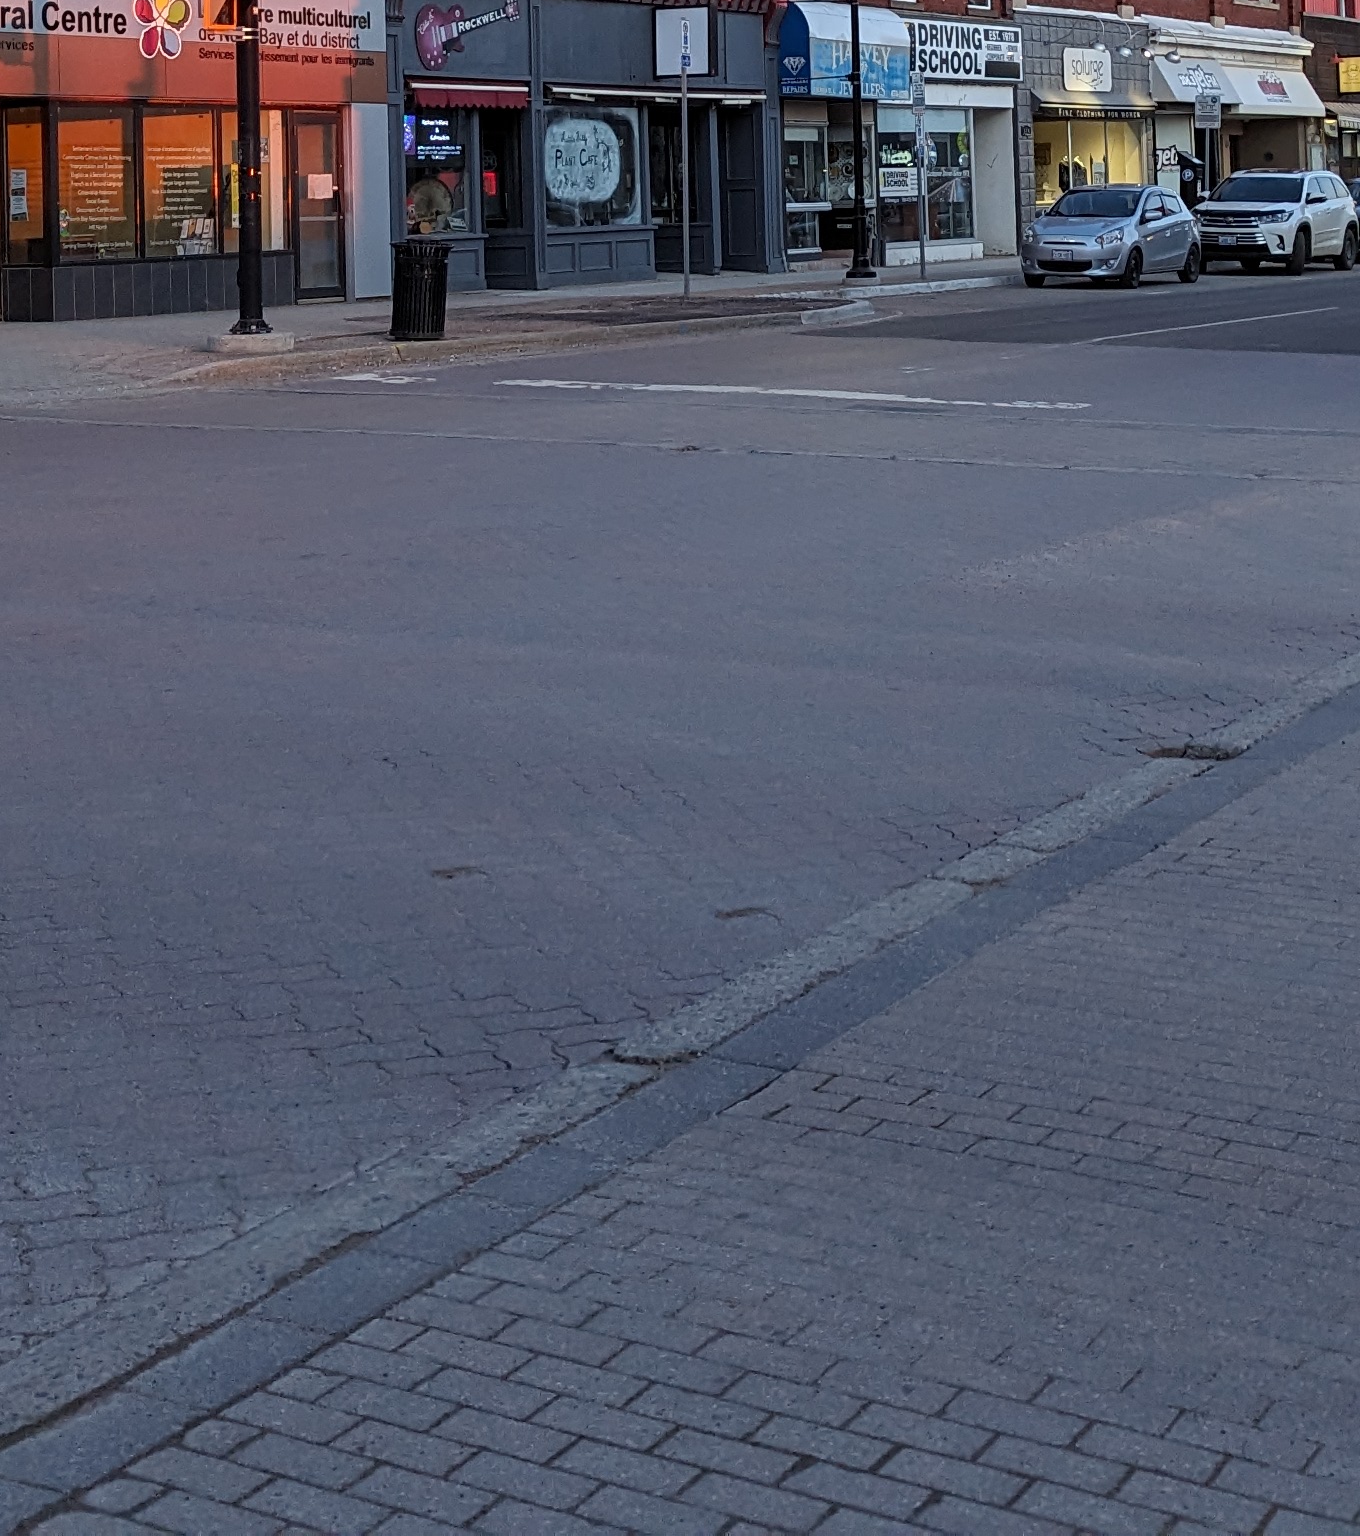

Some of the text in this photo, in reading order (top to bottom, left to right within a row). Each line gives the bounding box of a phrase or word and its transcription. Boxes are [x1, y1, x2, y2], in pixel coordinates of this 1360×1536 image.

[41, 1, 127, 35] Centre
[278, 7, 371, 30] multiculturel
[457, 9, 507, 33] ROCKWELL
[259, 29, 284, 49] Bay
[287, 31, 299, 46] et
[302, 31, 317, 47] du
[320, 31, 361, 50] district
[918, 23, 983, 51] DRIVING
[198, 47, 235, 61] Services
[301, 53, 318, 66] pour
[321, 52, 333, 64] les
[917, 48, 982, 76] SCHOOL
[1071, 51, 1104, 81] splurge
[782, 85, 809, 95] REPAIRS
[1058, 107, 1073, 117] FINE
[1120, 111, 1141, 119] WOMEN
